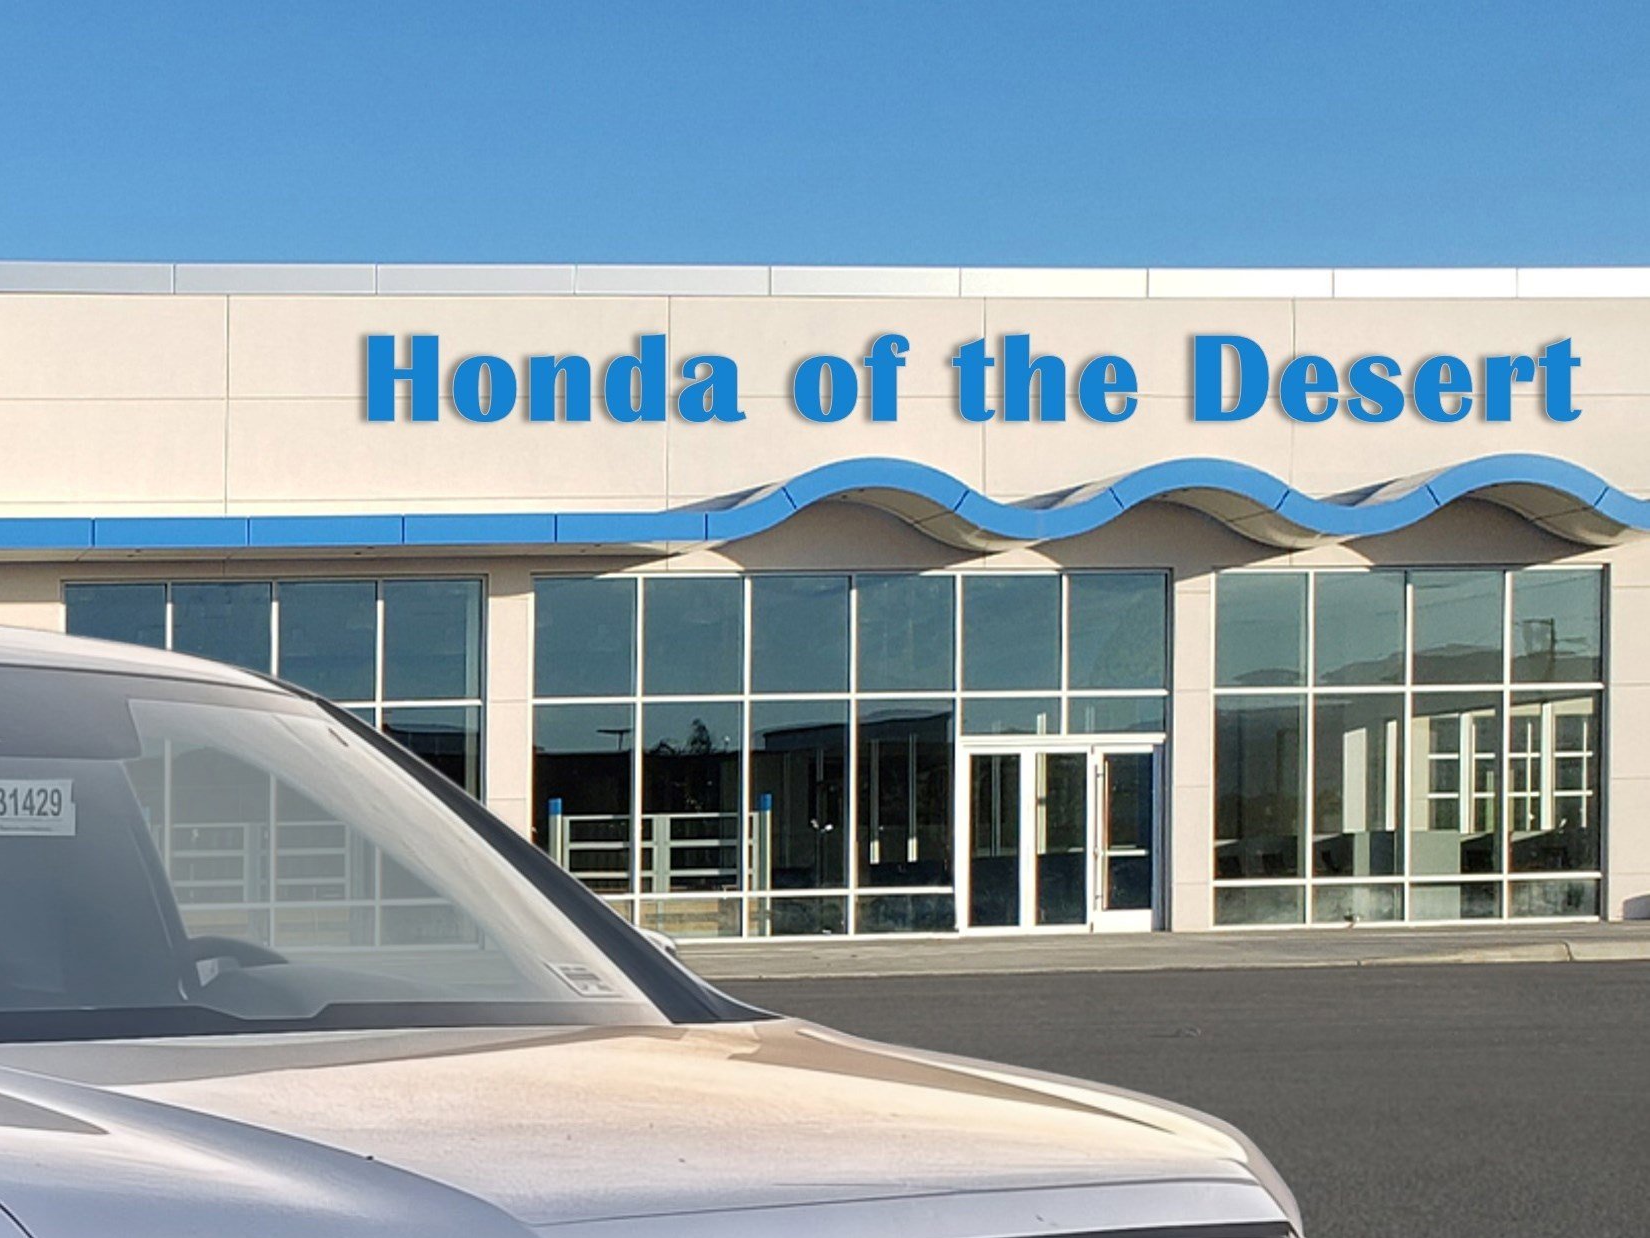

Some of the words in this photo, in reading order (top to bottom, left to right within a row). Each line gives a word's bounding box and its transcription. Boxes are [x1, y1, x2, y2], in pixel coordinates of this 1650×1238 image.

[364, 333, 747, 424] Honda
[793, 333, 910, 425] of
[952, 333, 1139, 425] the
[1193, 335, 1583, 425] Desert
